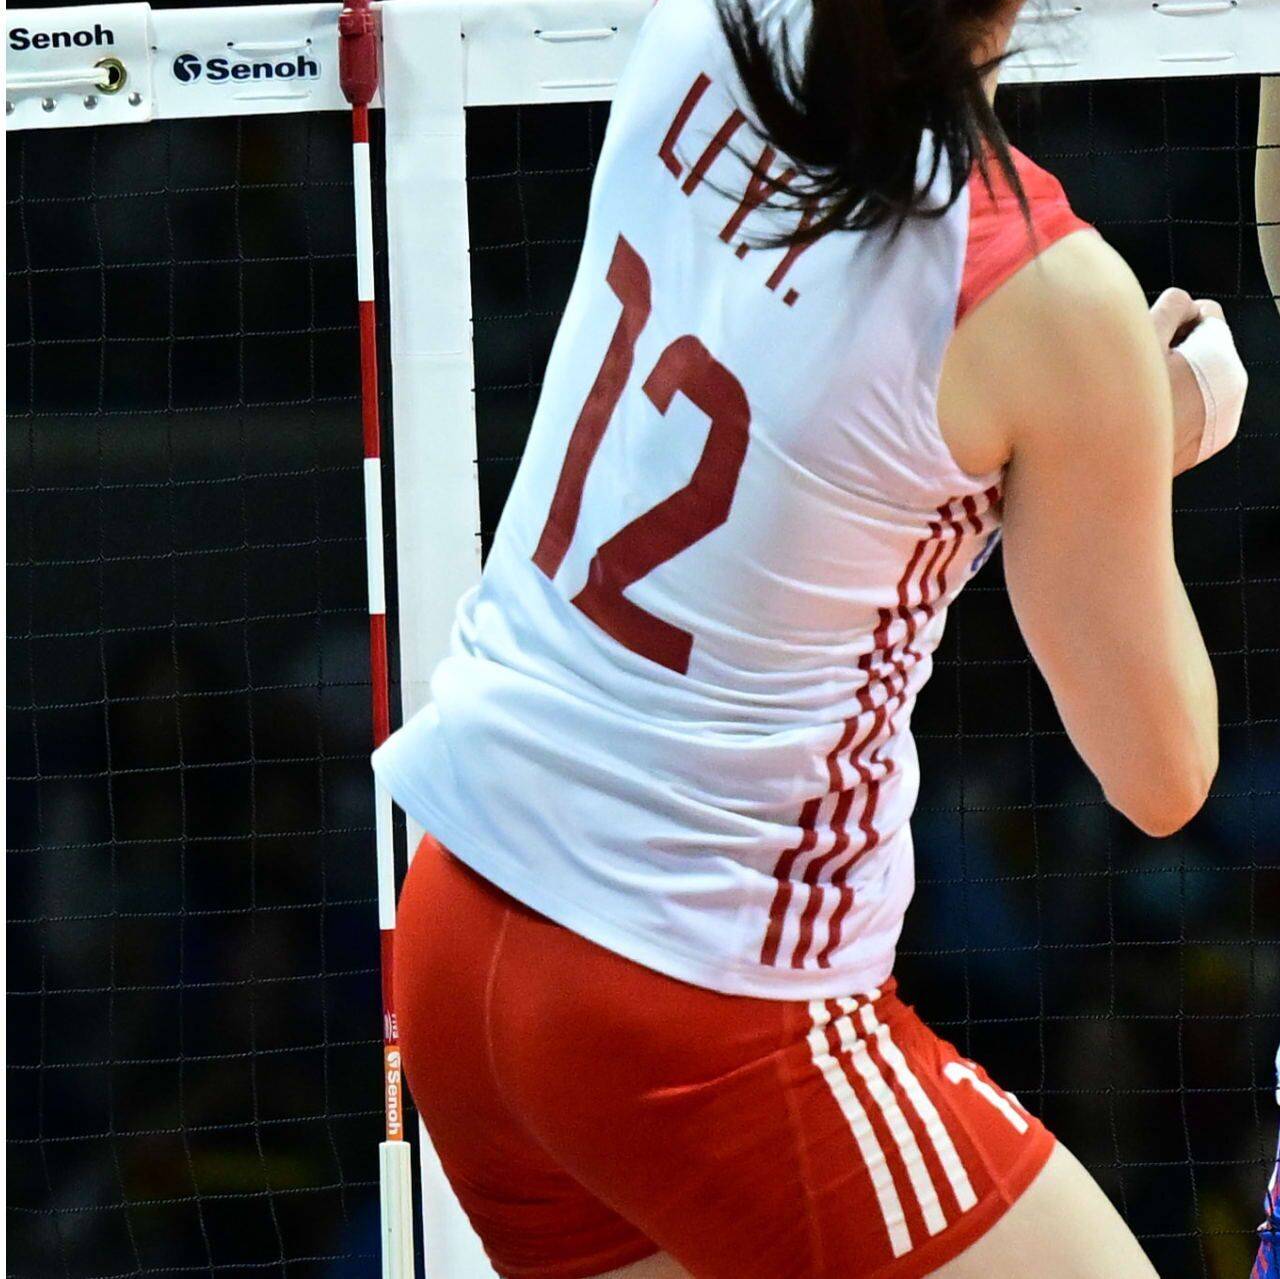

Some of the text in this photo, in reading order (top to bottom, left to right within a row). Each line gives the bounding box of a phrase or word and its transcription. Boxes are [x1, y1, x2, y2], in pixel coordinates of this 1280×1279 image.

[9, 24, 115, 51] Senoh
[206, 56, 319, 80] Senoh
[658, 71, 747, 197] LI
[532, 232, 752, 676] 12
[386, 1070, 401, 1136] Senoh
[943, 1061, 1030, 1135] 1
